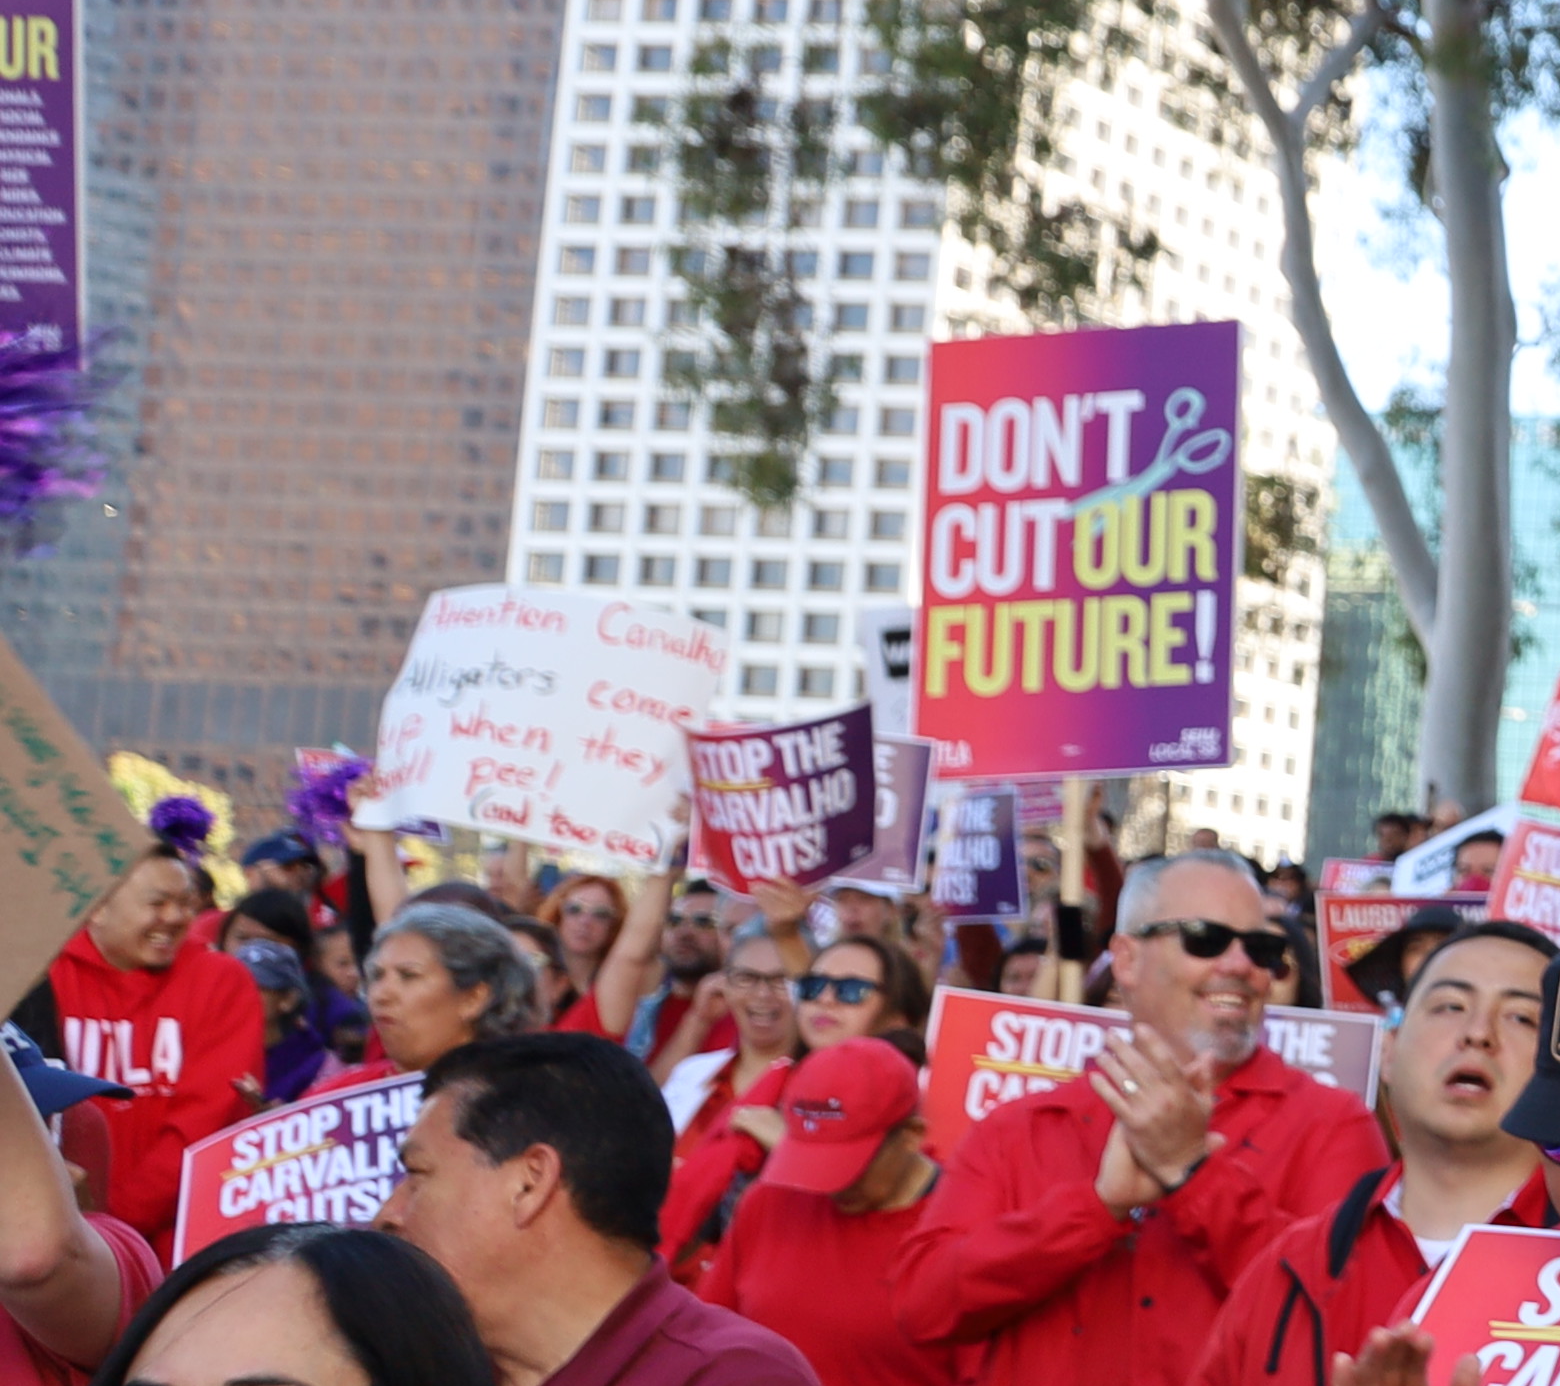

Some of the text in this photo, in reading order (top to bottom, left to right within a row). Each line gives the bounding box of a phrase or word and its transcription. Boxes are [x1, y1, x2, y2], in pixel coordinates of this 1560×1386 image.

[0, 15, 60, 83] UR
[937, 389, 1144, 496] DON'T
[930, 488, 1218, 598] CUT OUR
[926, 591, 1216, 699] FUTURE!
[586, 679, 696, 725] come
[773, 720, 846, 779] THE
[731, 823, 828, 883] CUTS!
[986, 1012, 1100, 1065] STOP
[231, 1103, 341, 1171] STOP
[219, 1130, 406, 1218] CARVALH
